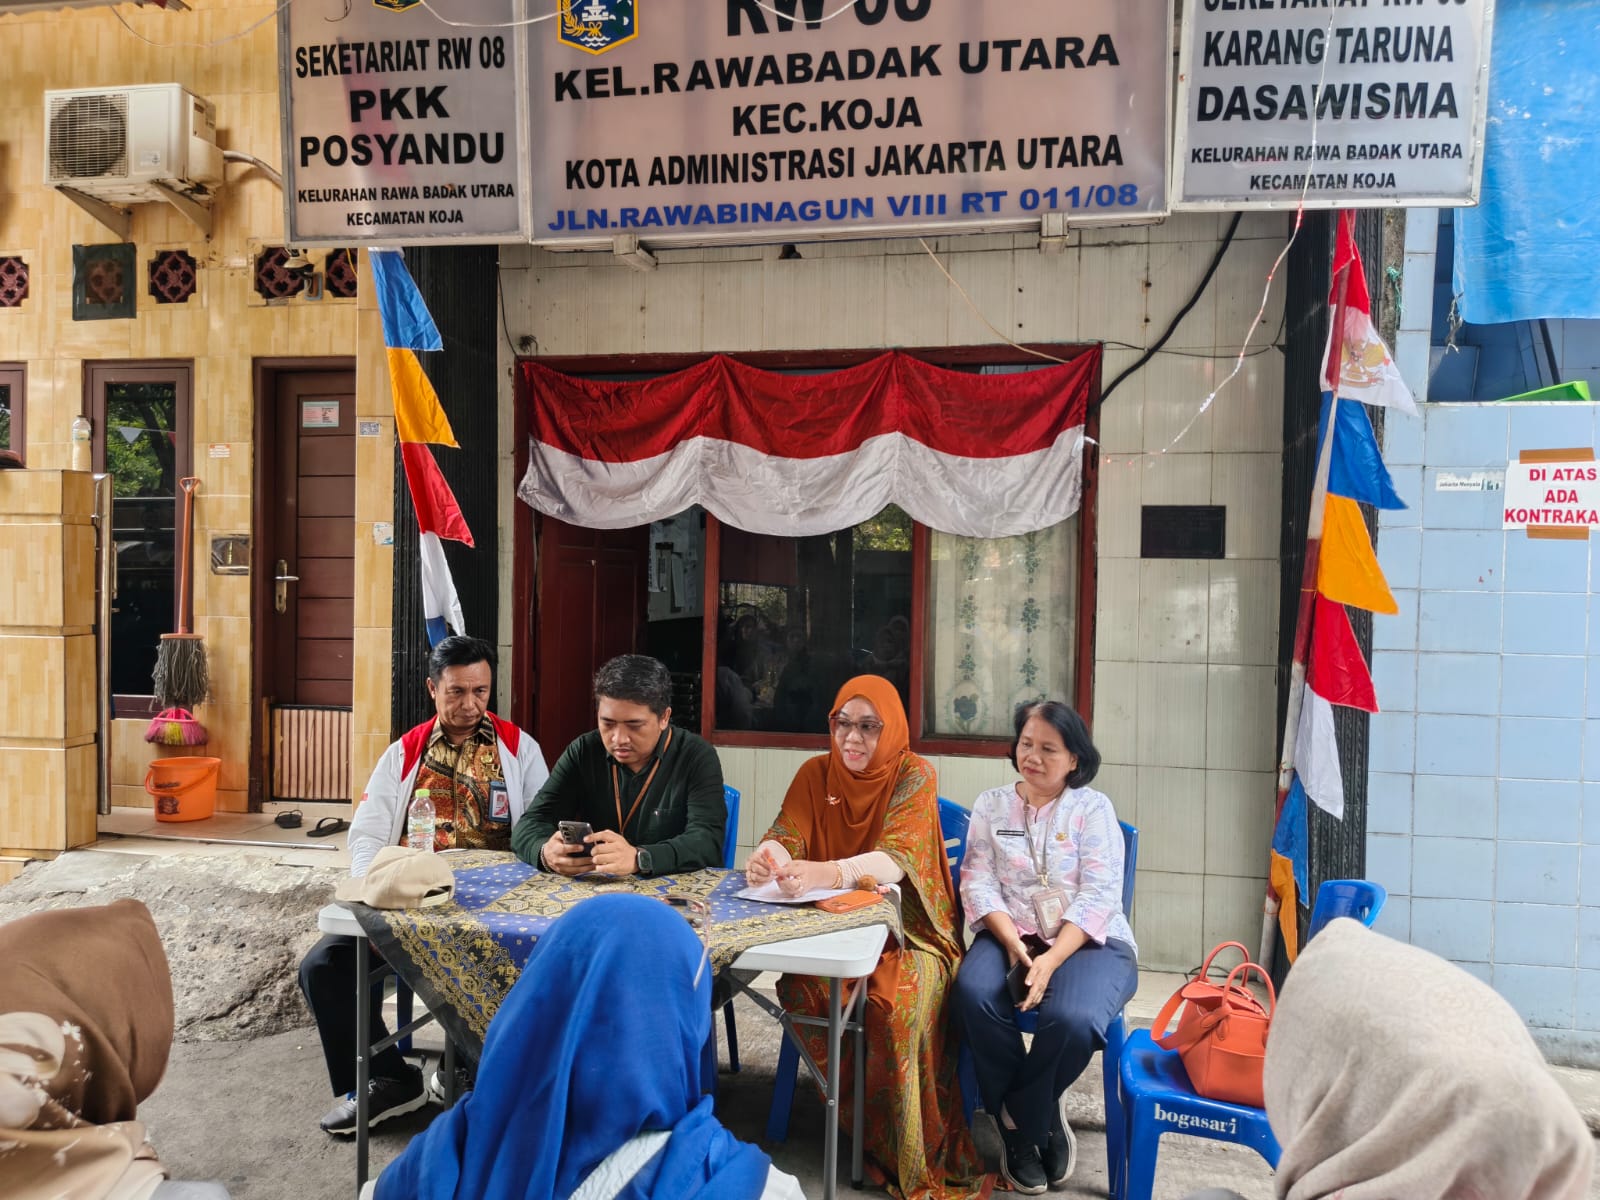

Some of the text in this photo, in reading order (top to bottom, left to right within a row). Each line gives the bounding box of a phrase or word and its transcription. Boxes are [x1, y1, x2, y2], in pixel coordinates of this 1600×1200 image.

[296, 36, 505, 78] SEKETARIAT RW 08
[1203, 25, 1454, 67] KARANG TARUNA
[555, 34, 1120, 102] KEL.RAWABADAK UTARA
[349, 86, 449, 123] PKK
[733, 97, 922, 136] KEC.KOJA
[1197, 82, 1459, 122] DASAWISMA
[300, 132, 504, 167] POSYANDU
[566, 134, 1123, 189] KOTA ADMINISTRASI JAKARTA UTARA
[1191, 143, 1463, 163] KELURAHAN RAWA BADAK UTARA
[298, 183, 515, 203] KELURAHAN RAWA BADAK UTARA
[1250, 173, 1396, 190] KECAMATAN KOJA
[347, 209, 464, 226] KECAMATAN KOJA
[548, 183, 1139, 231] JLN.RAWABINAGUN VIII RT 011/08
[1529, 468, 1597, 481] DI ATAS
[1544, 489, 1579, 503] ADA
[1504, 508, 1599, 524] KONTRAKA
[1154, 1102, 1237, 1134] bogasari
